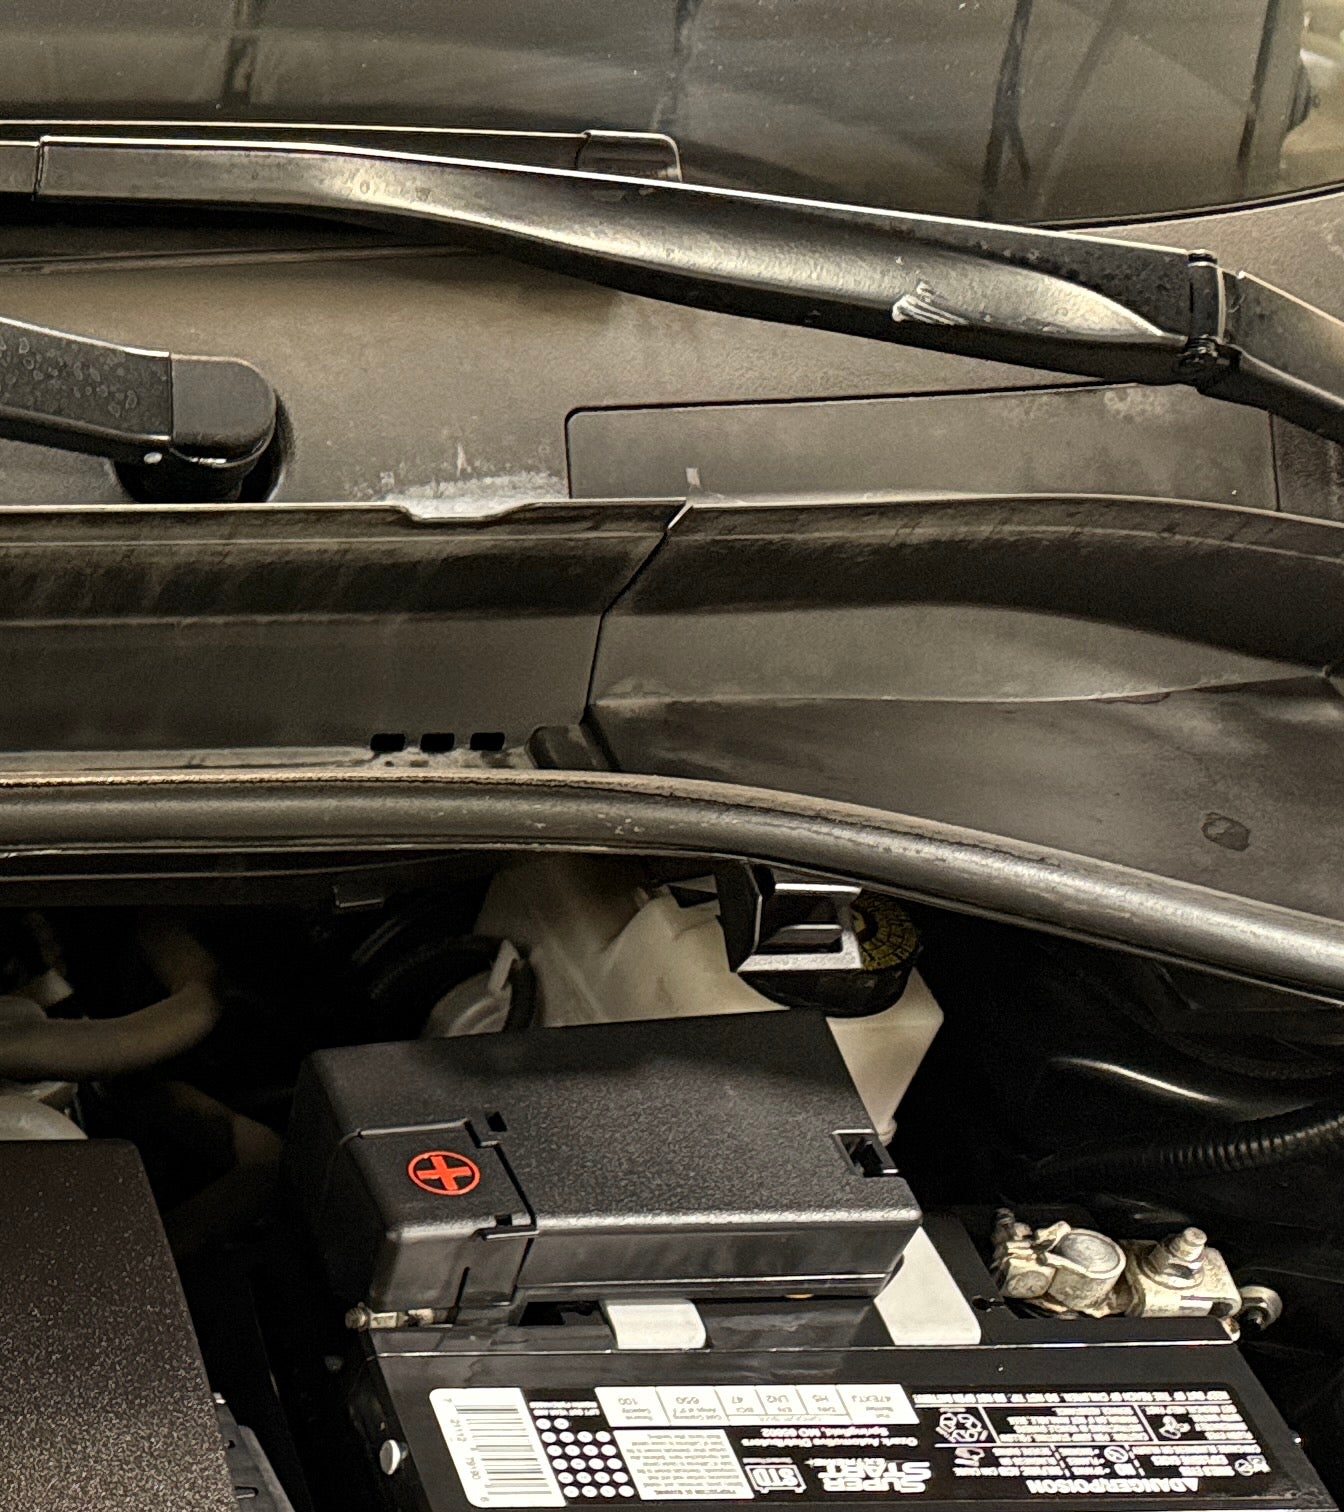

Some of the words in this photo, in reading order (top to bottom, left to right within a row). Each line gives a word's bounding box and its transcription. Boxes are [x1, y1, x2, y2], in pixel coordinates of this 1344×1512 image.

[752, 1468, 799, 1487] STD
[817, 1461, 932, 1481] START
[822, 1477, 926, 1493] SUPER
